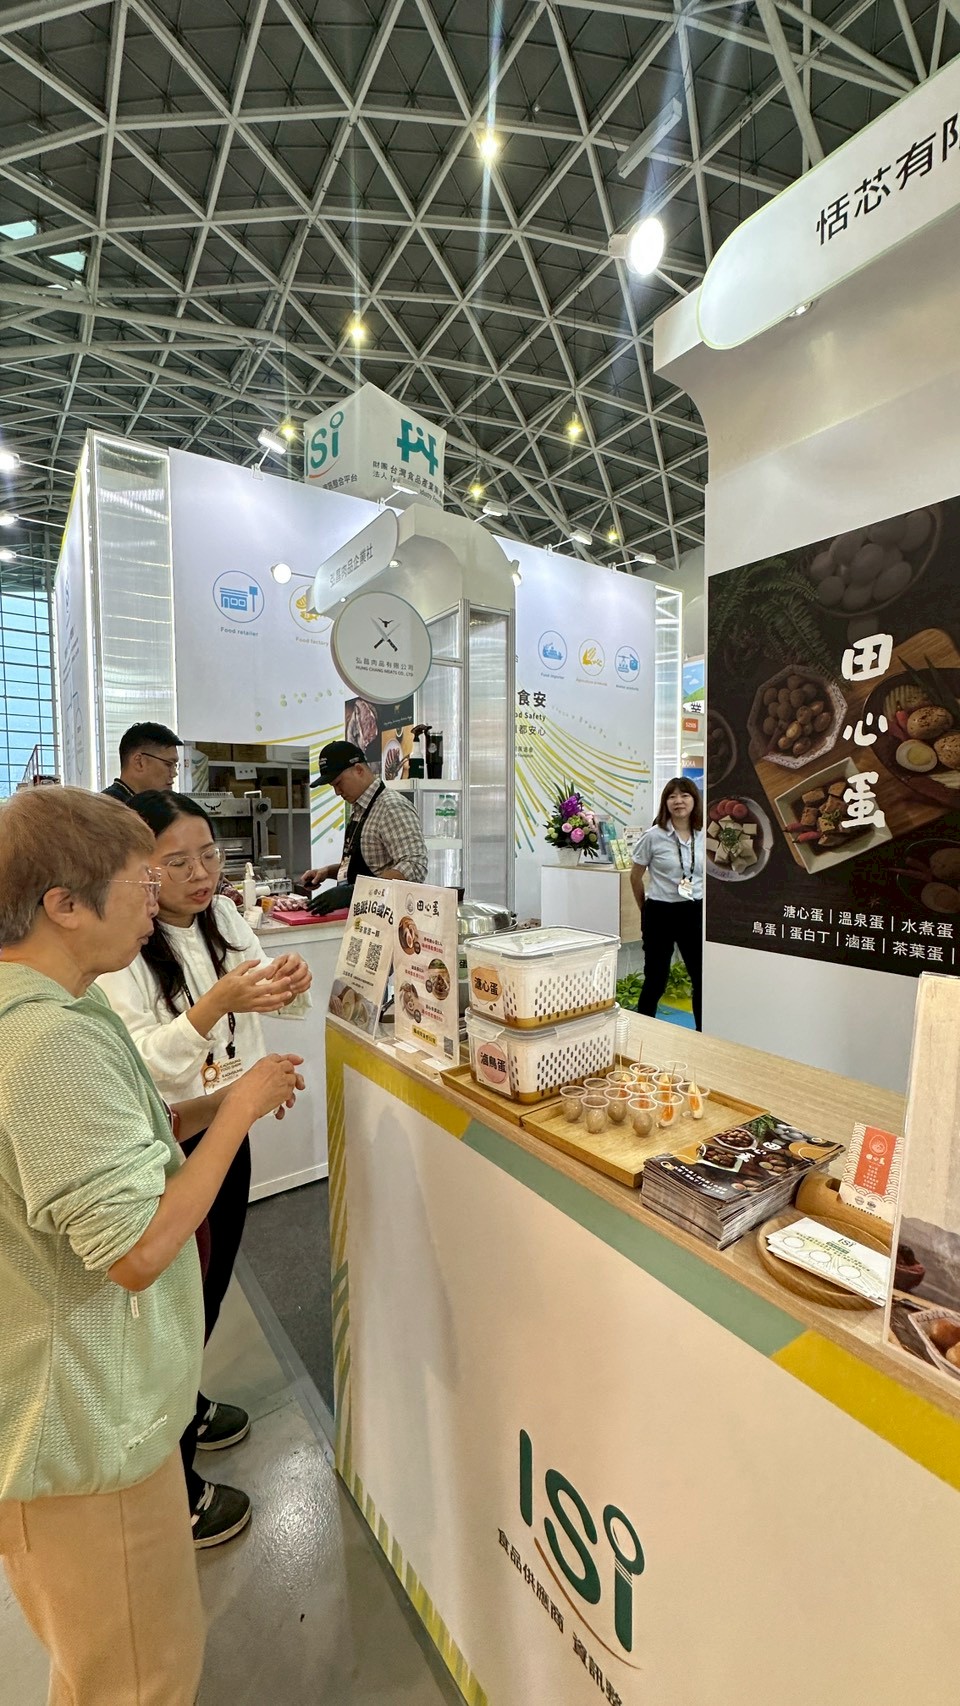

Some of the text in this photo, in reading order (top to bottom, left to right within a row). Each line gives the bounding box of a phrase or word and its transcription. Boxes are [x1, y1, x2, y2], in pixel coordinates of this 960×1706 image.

[372, 471, 387, 480] 法人
[220, 626, 259, 637] Food retailer
[295, 636, 329, 646] Food factory
[517, 689, 547, 708] 食安
[524, 711, 547, 723] Safety
[841, 633, 894, 829] 田心蛋
[416, 899, 440, 917] 田心蛋
[783, 904, 954, 939] 溏心蛋 溫泉蛋 水煮蛋
[752, 921, 944, 962] 鳥蛋 蛋白丁 滷蛋 茶葉蛋
[497, 1527, 564, 1634] 食品供應商
